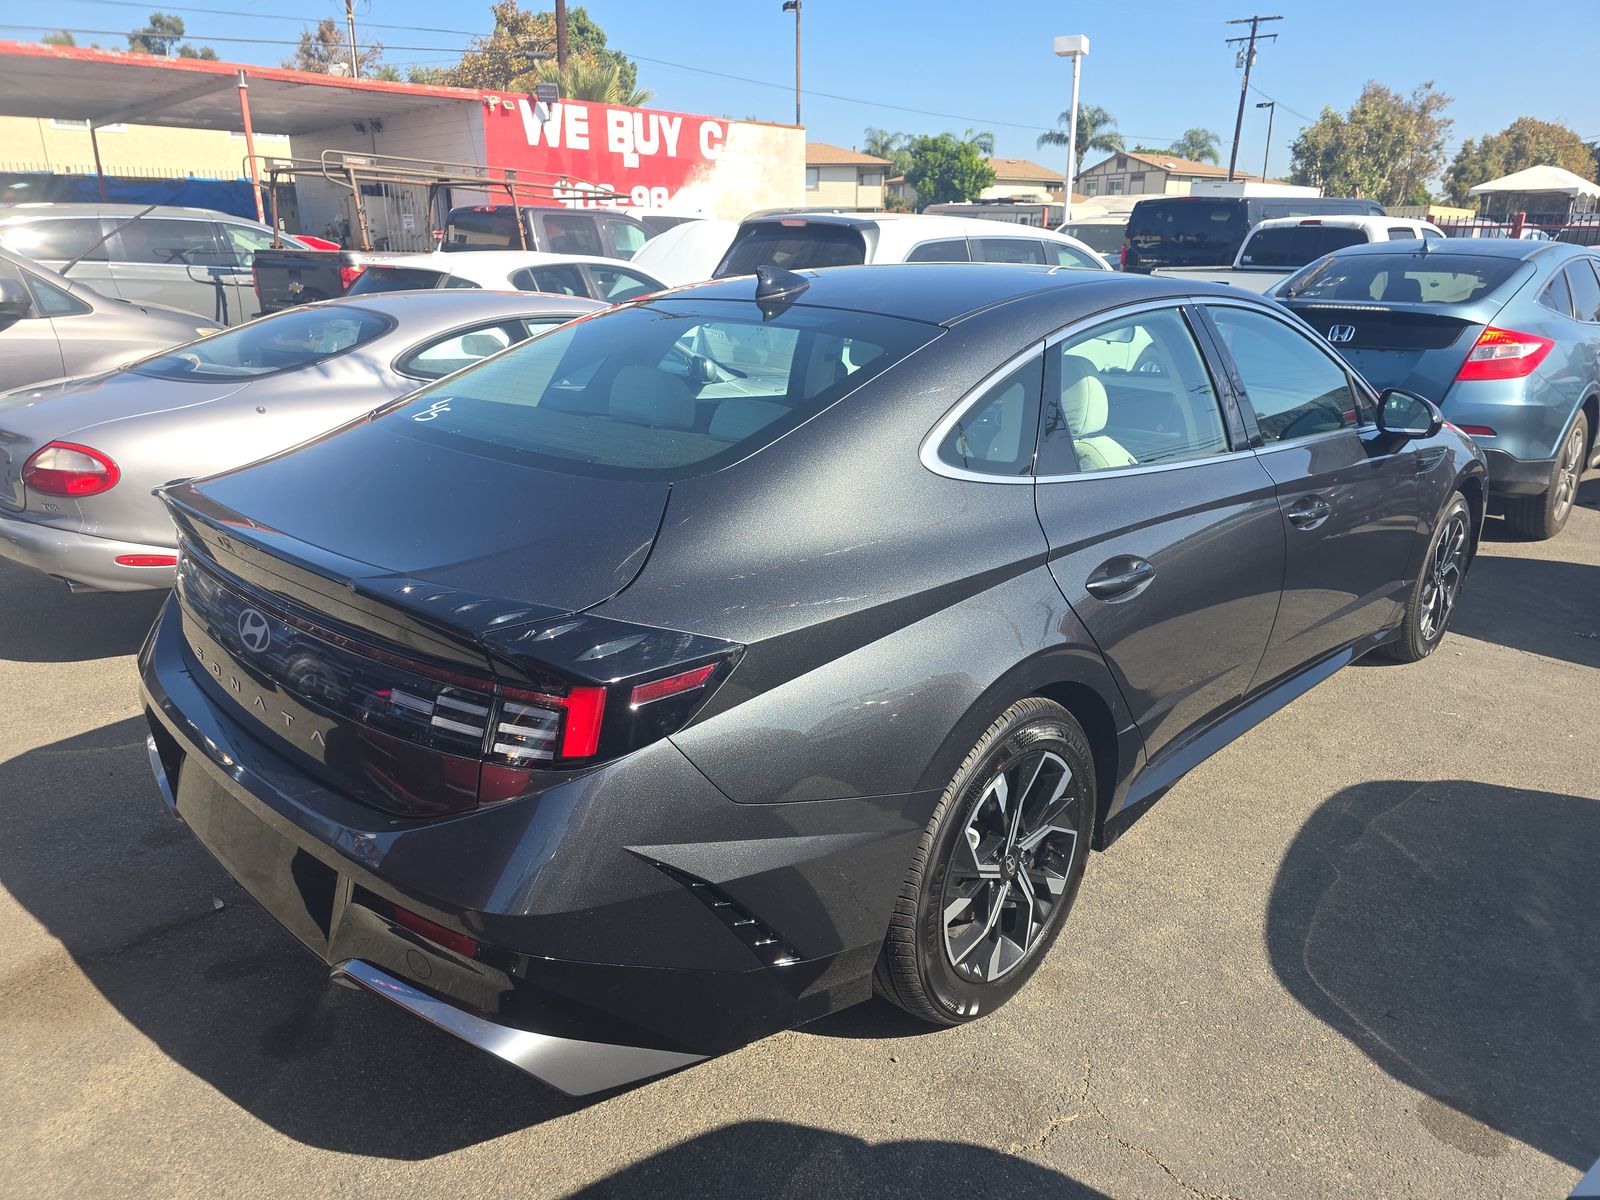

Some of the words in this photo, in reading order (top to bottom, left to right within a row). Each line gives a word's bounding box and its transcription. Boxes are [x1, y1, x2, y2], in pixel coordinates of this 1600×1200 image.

[518, 99, 590, 150] WE
[606, 109, 682, 157] BUY
[195, 646, 326, 747] SONATA
